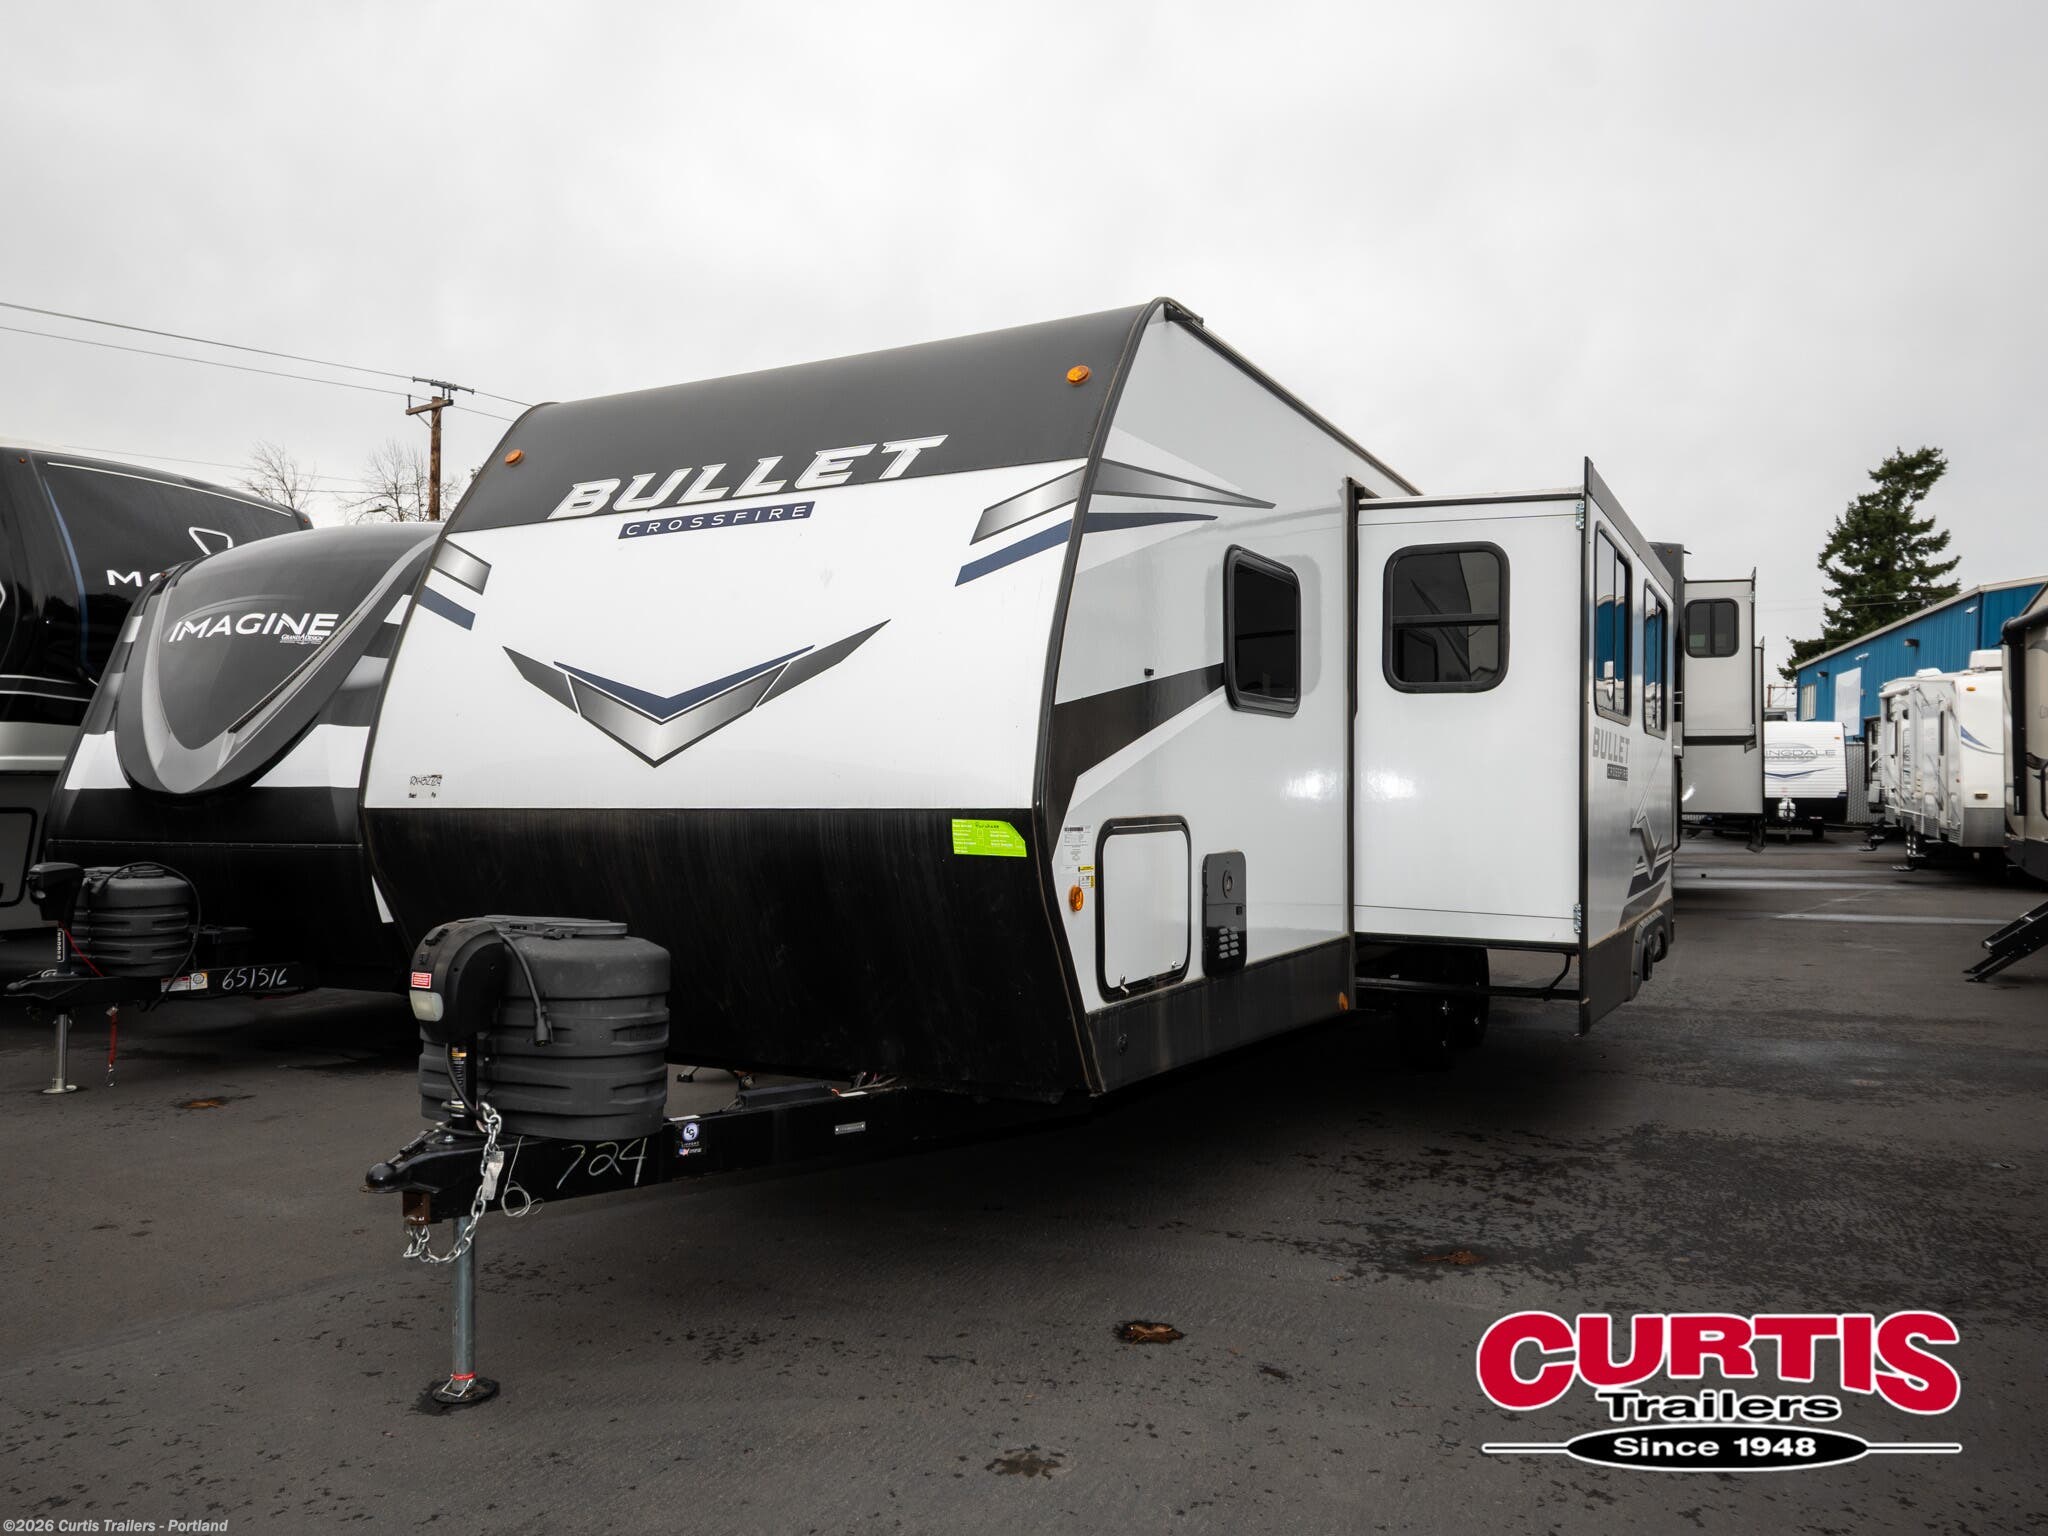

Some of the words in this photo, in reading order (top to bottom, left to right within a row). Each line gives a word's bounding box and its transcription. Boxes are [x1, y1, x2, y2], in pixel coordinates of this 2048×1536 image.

[547, 434, 949, 520] BULLET
[624, 504, 808, 537] CROSSFIRE
[168, 612, 339, 643] IMAGINE
[1592, 726, 1631, 764] BULLET
[222, 967, 288, 990] 651516
